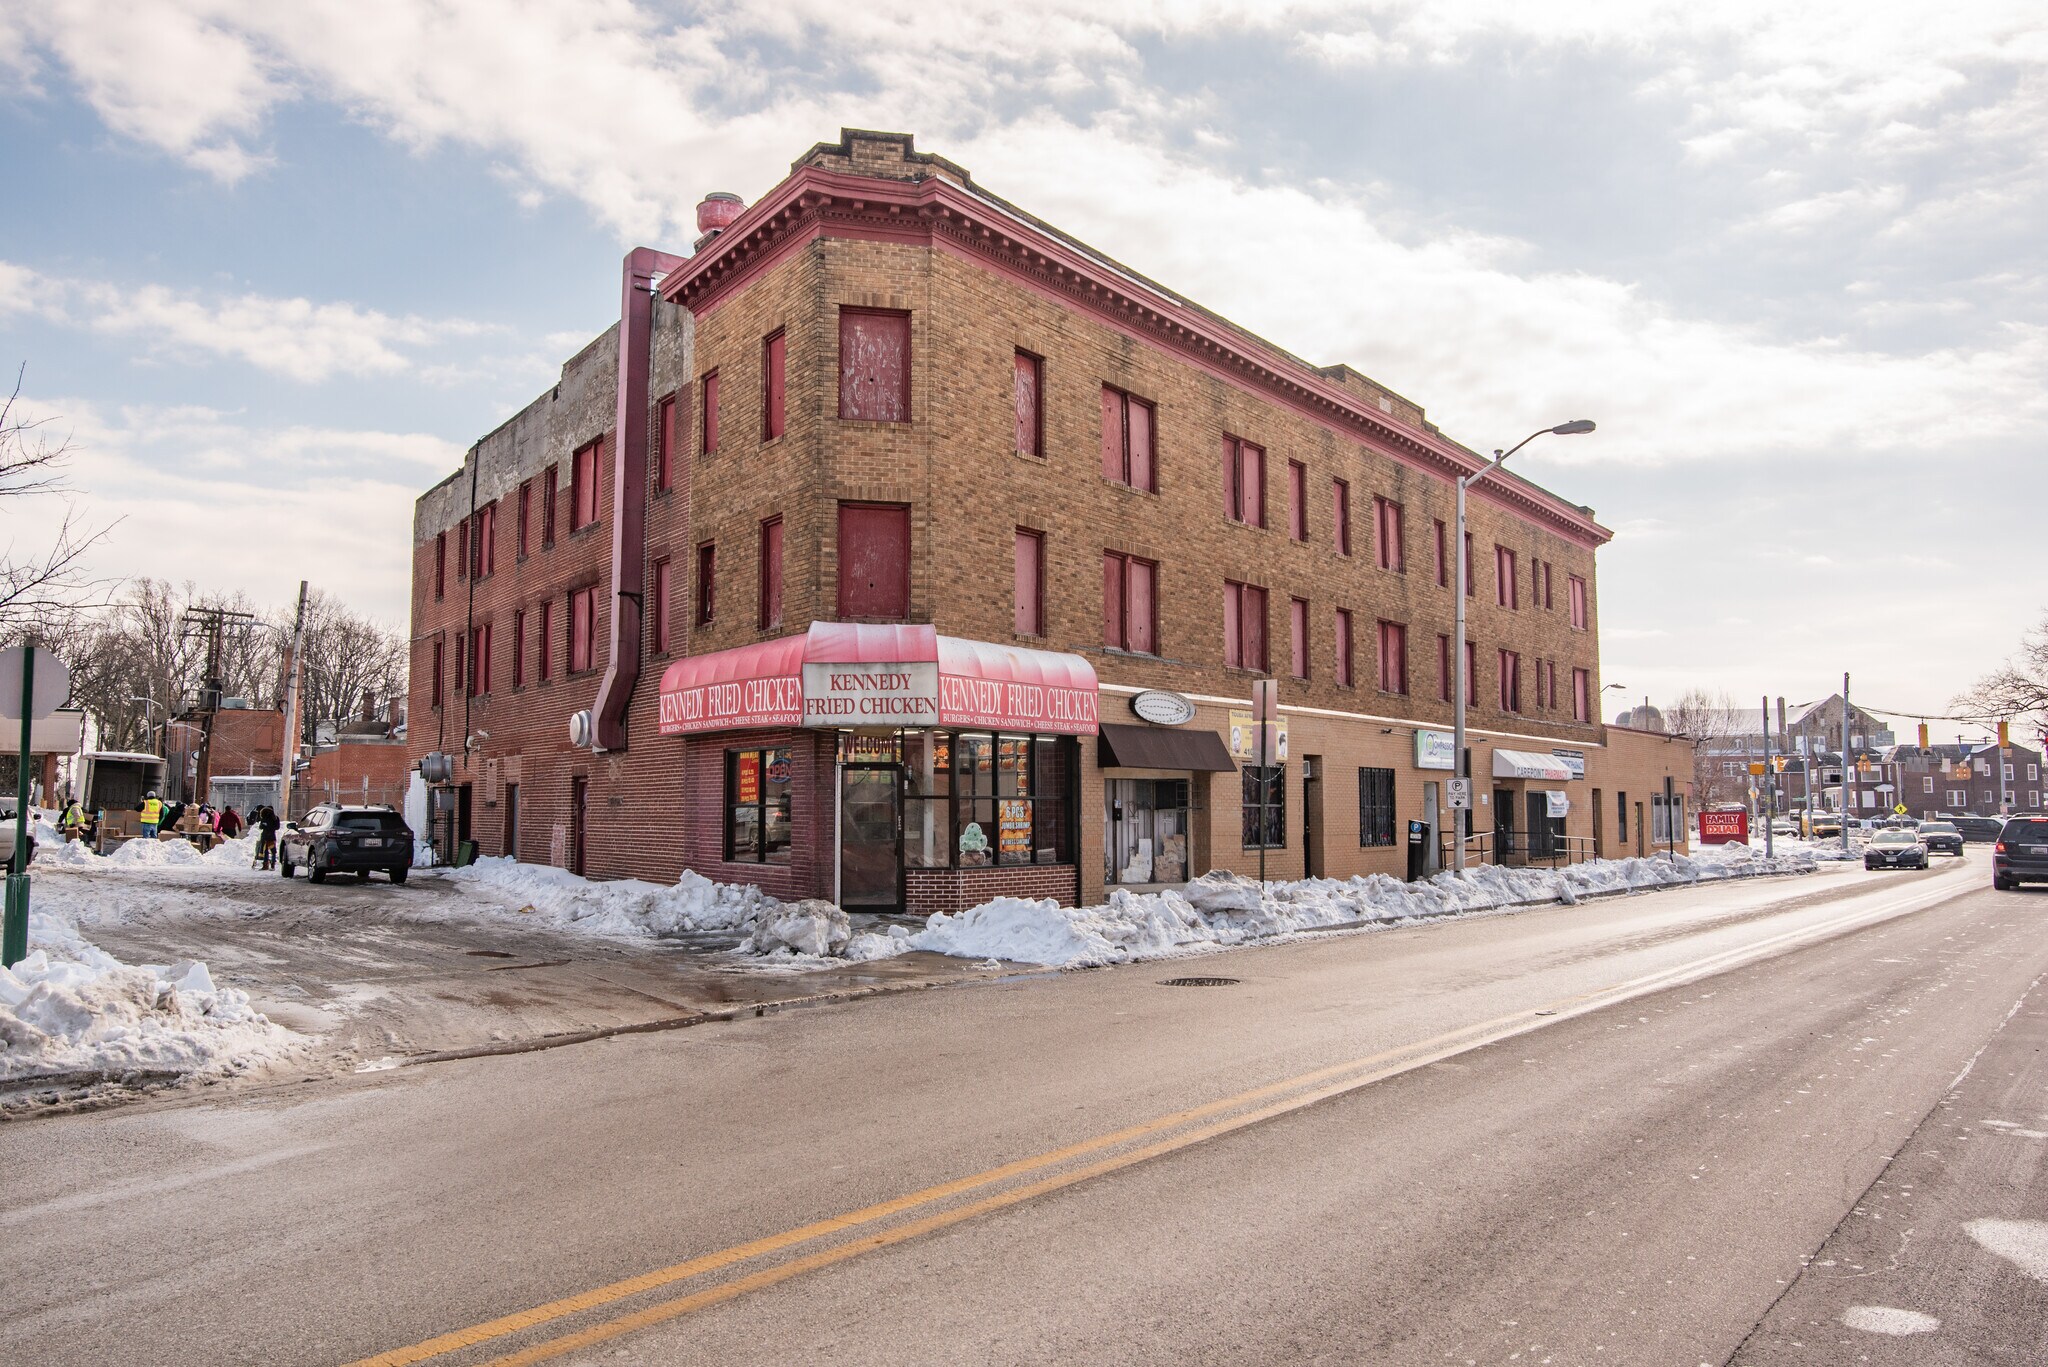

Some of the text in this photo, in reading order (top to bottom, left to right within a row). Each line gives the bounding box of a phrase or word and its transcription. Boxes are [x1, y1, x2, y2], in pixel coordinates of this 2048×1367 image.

[830, 673, 912, 691] KENNEDY
[660, 688, 704, 723] KENNEDY
[708, 683, 741, 717] FRIED
[806, 697, 937, 715] FRIED CHICKEN
[940, 676, 1097, 721] KENNEDY FRIED CHICKEN
[661, 724, 680, 733] BURGERS
[682, 722, 703, 731] CHICKEN
[703, 718, 729, 728] SANDWICH
[732, 716, 751, 725] CHEESE
[751, 715, 769, 723] STEAK
[943, 713, 1096, 732] BURGERS CHICKEN SANDWICH CHEESE STEAK SEAFOOD
[844, 736, 896, 754] WELCOME
[769, 763, 791, 777] OPEN
[1517, 767, 1544, 778] CAREPOINT
[1545, 769, 1568, 780] PHARMACY
[1006, 806, 1010, 818] 6
[1706, 814, 1739, 824] FAMILY
